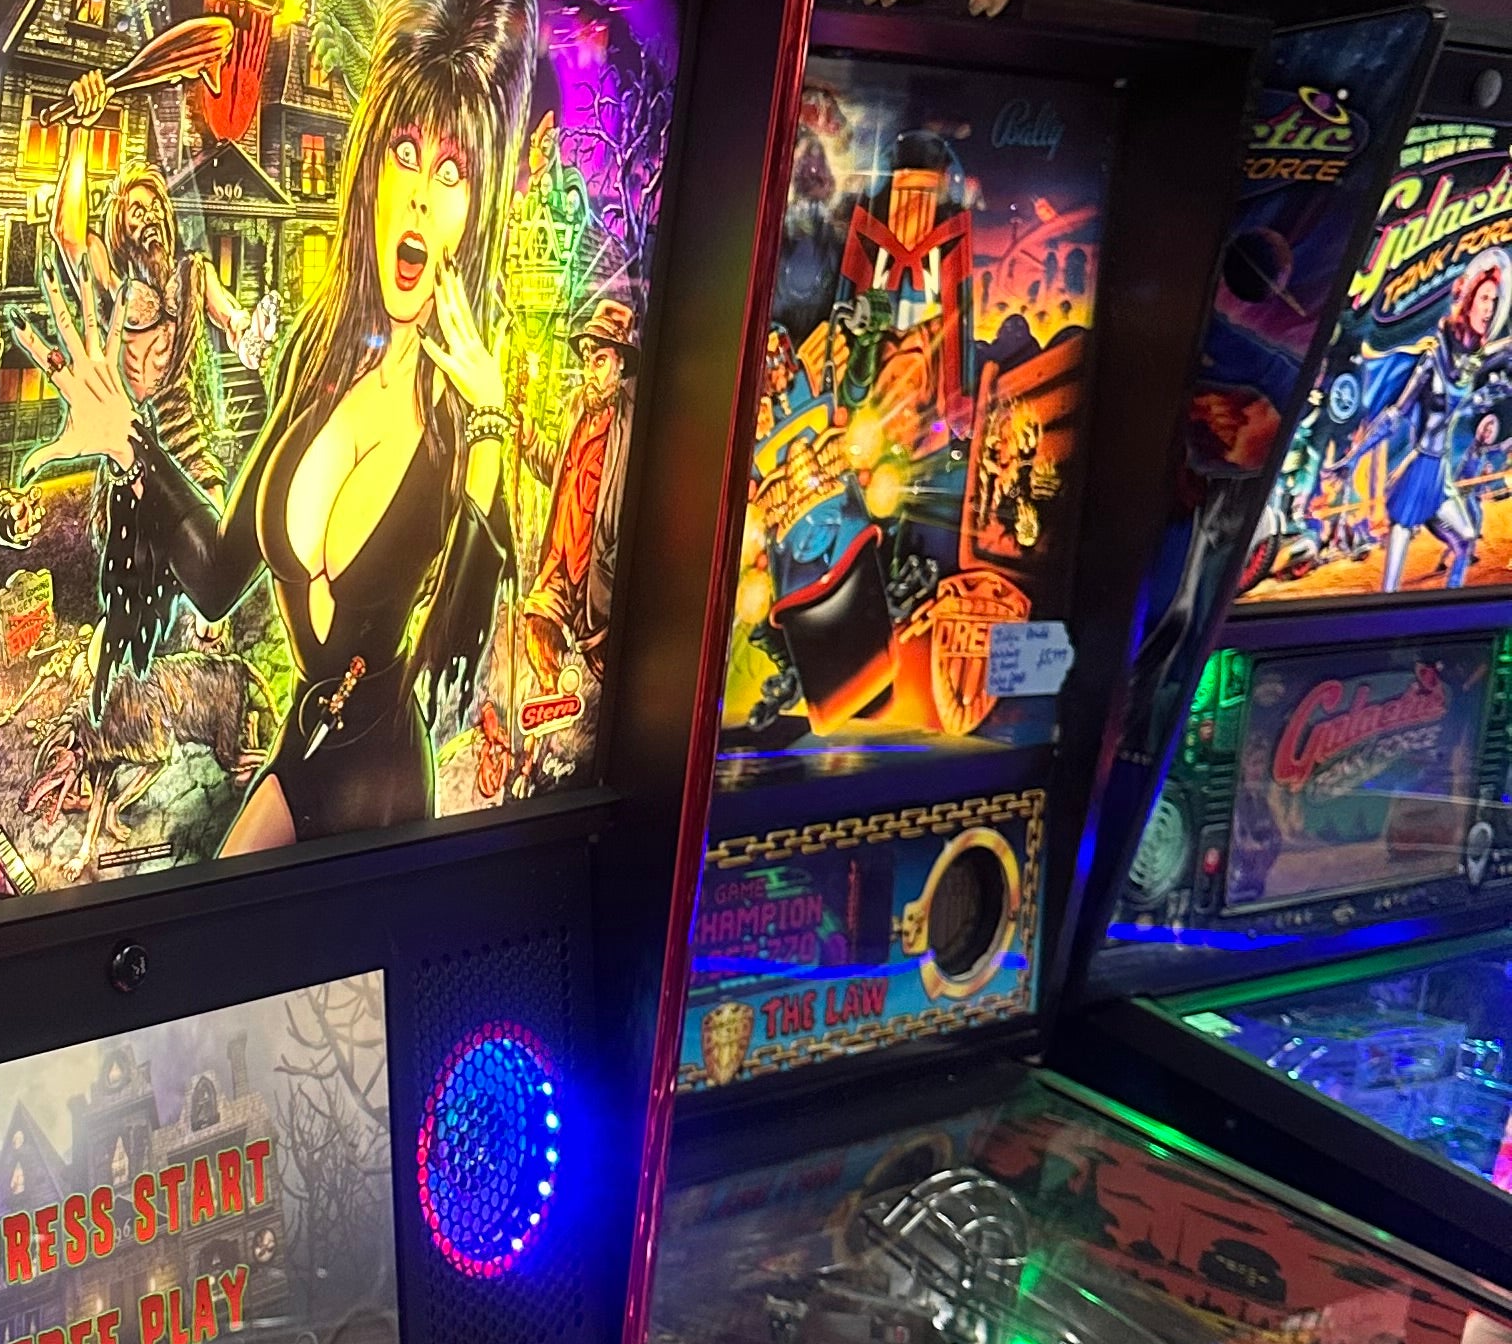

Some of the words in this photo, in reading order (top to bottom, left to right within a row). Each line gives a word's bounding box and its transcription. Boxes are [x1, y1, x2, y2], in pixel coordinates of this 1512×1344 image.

[938, 621, 990, 653] DRE
[524, 701, 576, 727] Stern
[714, 877, 767, 904] GAME
[698, 894, 823, 943] HAMPION
[761, 991, 817, 1039] THE
[824, 976, 889, 1027] LAW
[133, 1137, 273, 1246] START
